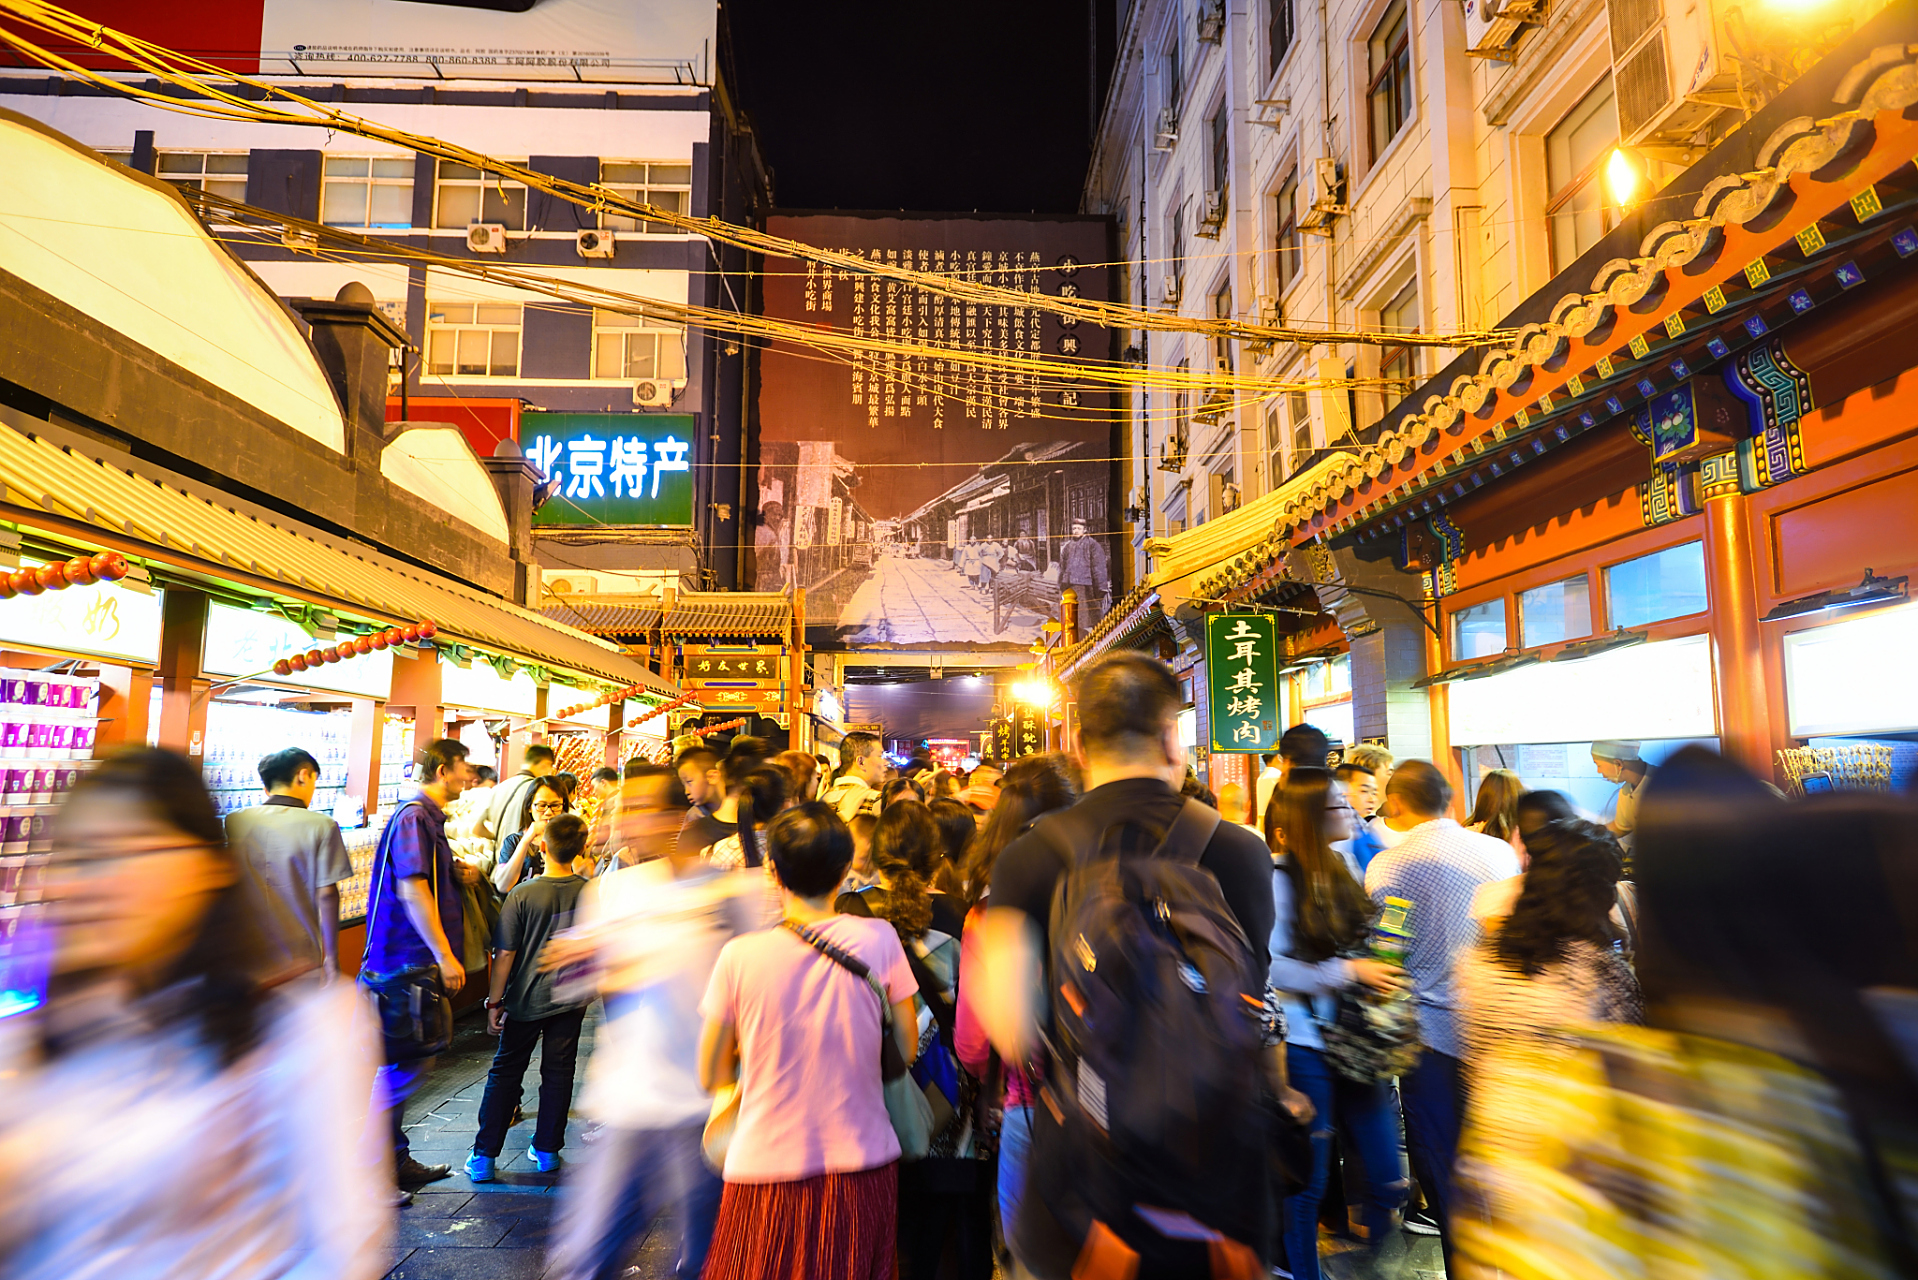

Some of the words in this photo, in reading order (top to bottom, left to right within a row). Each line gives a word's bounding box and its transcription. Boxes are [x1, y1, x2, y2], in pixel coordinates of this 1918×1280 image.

[347, 53, 418, 63] 400-627-7788
[426, 55, 497, 65] 800-860-8388
[1061, 259, 1077, 405] 小吃街興記
[525, 434, 690, 499] 北京特产
[697, 659, 767, 674] 好友世界
[1224, 620, 1263, 744] 土耳其烤肉
[997, 724, 1011, 760] 烤羊肉串
